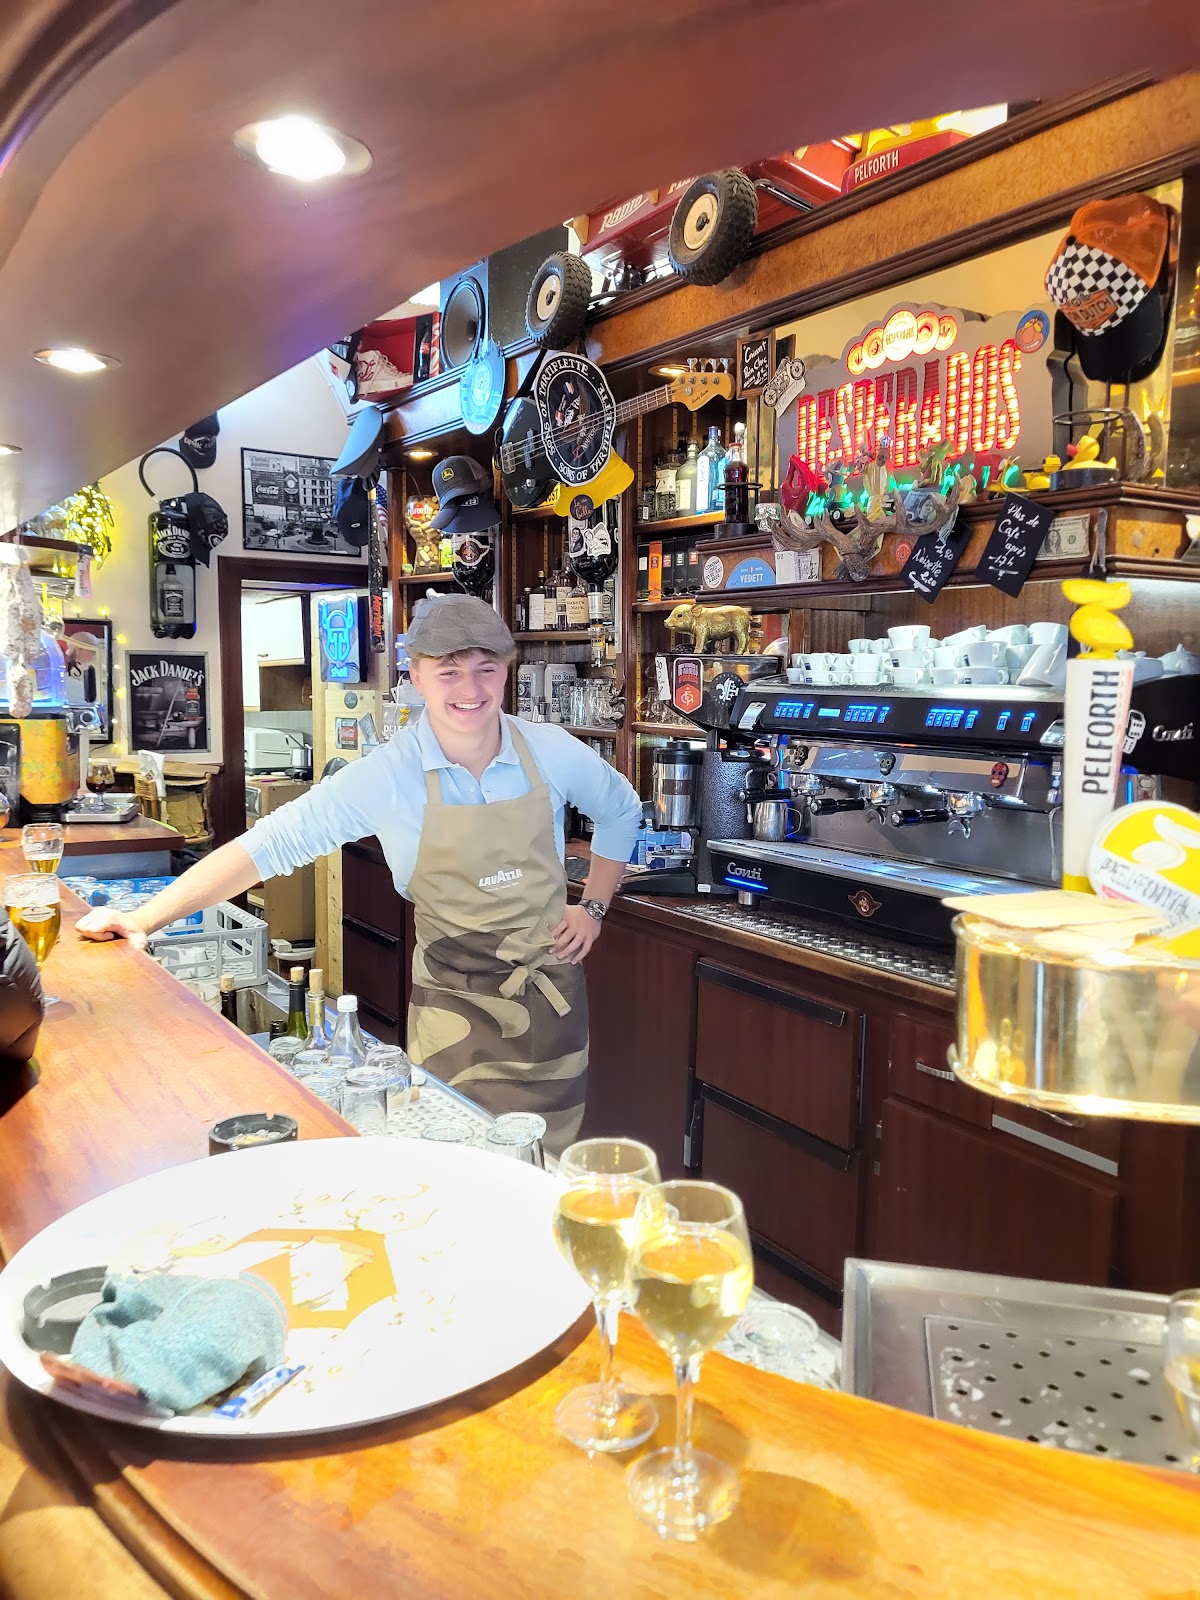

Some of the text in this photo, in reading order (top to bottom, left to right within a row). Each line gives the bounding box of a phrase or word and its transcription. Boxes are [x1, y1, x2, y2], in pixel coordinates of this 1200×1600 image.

[854, 150, 899, 184] PELFORTH
[599, 194, 646, 234] RADIO
[538, 358, 589, 399] TARTIFLETTE
[541, 401, 548, 418] OF
[797, 339, 1022, 486] DESPERADOS
[543, 421, 555, 456] SONS
[558, 462, 575, 482] SONS
[577, 470, 588, 480] OF
[1007, 502, 1040, 527] Plus de
[998, 518, 1026, 542] Café
[1004, 543, 1026, 558] après
[705, 559, 720, 570] CORONA
[740, 573, 764, 583] VEDETT
[130, 660, 205, 687] JACK DANIEL'S
[1081, 670, 1120, 795] PELFORTH
[1152, 722, 1195, 742] Conti
[479, 868, 523, 887] LAVAZZA
[727, 861, 762, 881] Conti
